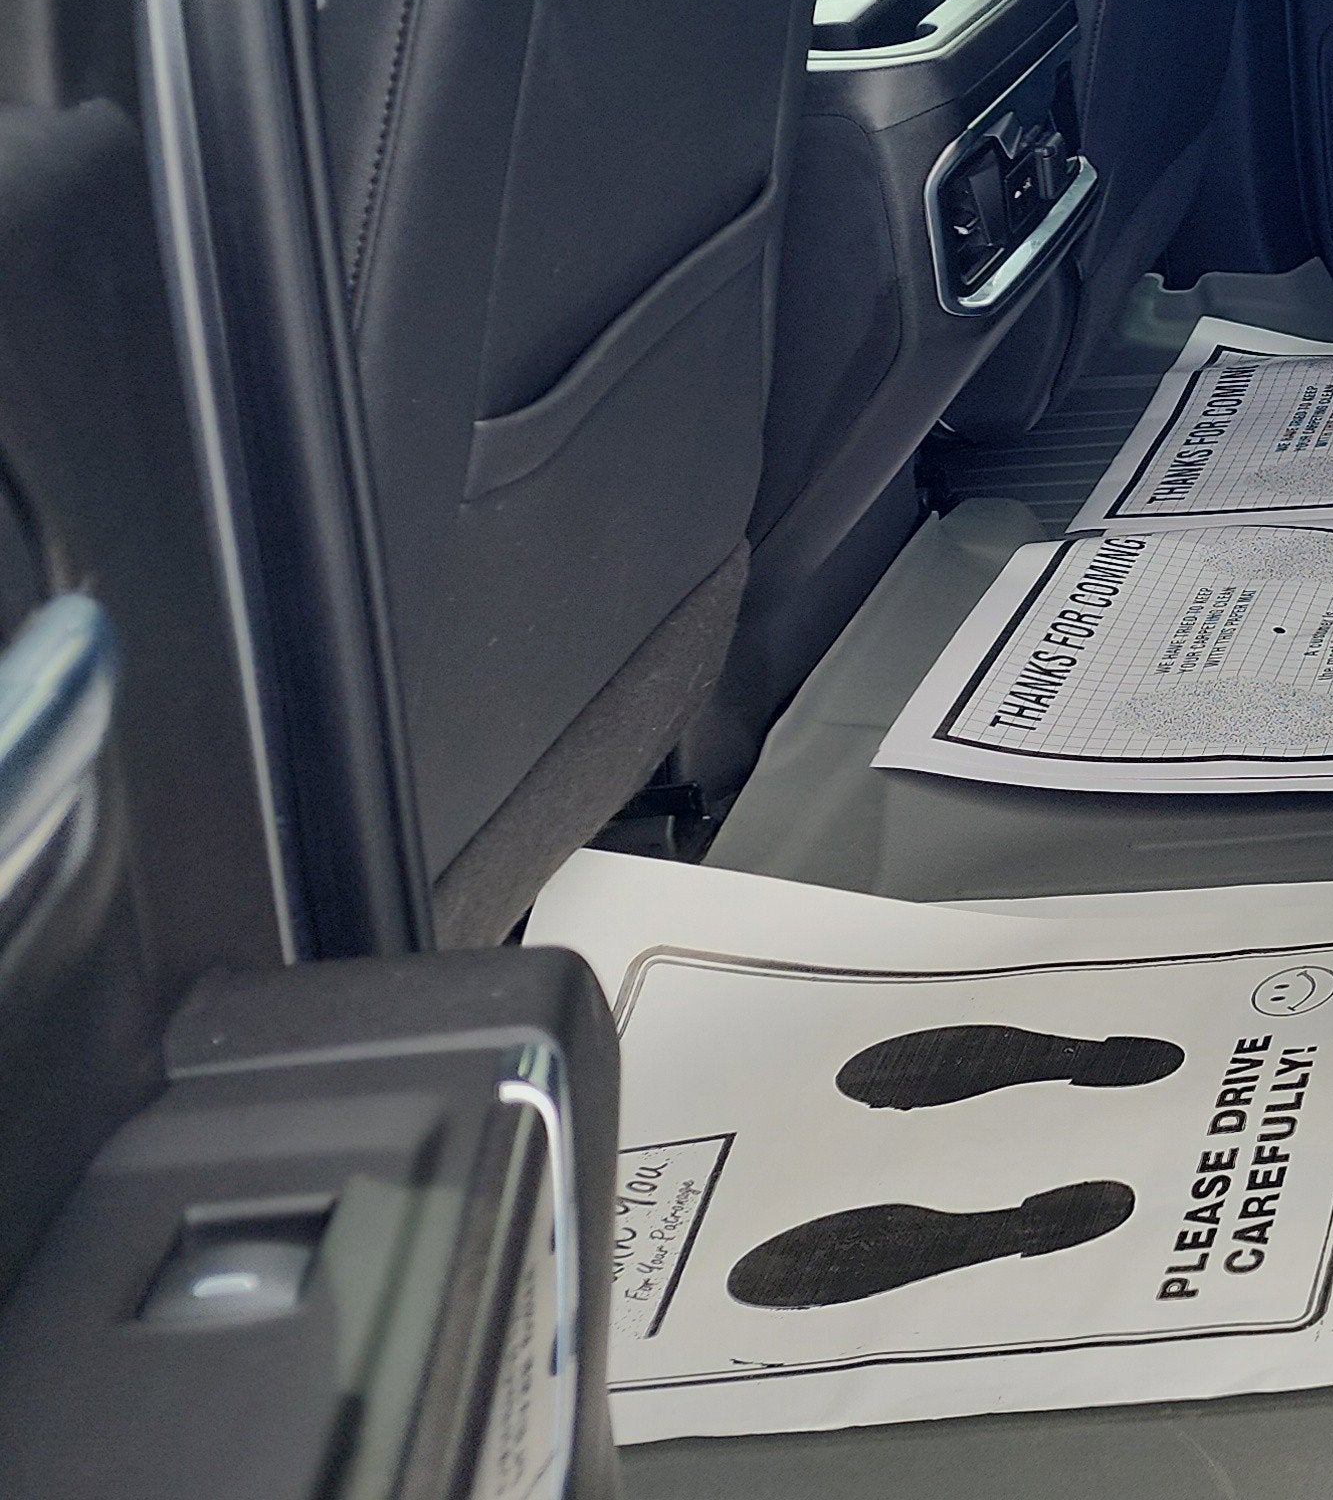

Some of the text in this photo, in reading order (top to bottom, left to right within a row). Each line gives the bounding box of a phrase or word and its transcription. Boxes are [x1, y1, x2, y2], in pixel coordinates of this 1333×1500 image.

[1147, 365, 1259, 504] THANKS FOR COMIN
[1302, 386, 1318, 401] KEEP
[990, 538, 1147, 730] THANKS FOR COMING
[1154, 587, 1213, 675] WE HAVE TRIED TO KEEP
[1177, 586, 1236, 674] YOUR CARPETING CLEAN
[1203, 589, 1256, 668] WITH THIS PAPER MAT
[1309, 619, 1333, 648] customer
[1156, 1035, 1272, 1300] PLEASE DRIVE
[1223, 1045, 1318, 1274] CAREFULLY!
[650, 1180, 702, 1241] Patronage
[625, 1278, 655, 1301] For
[637, 1245, 668, 1273] Your
